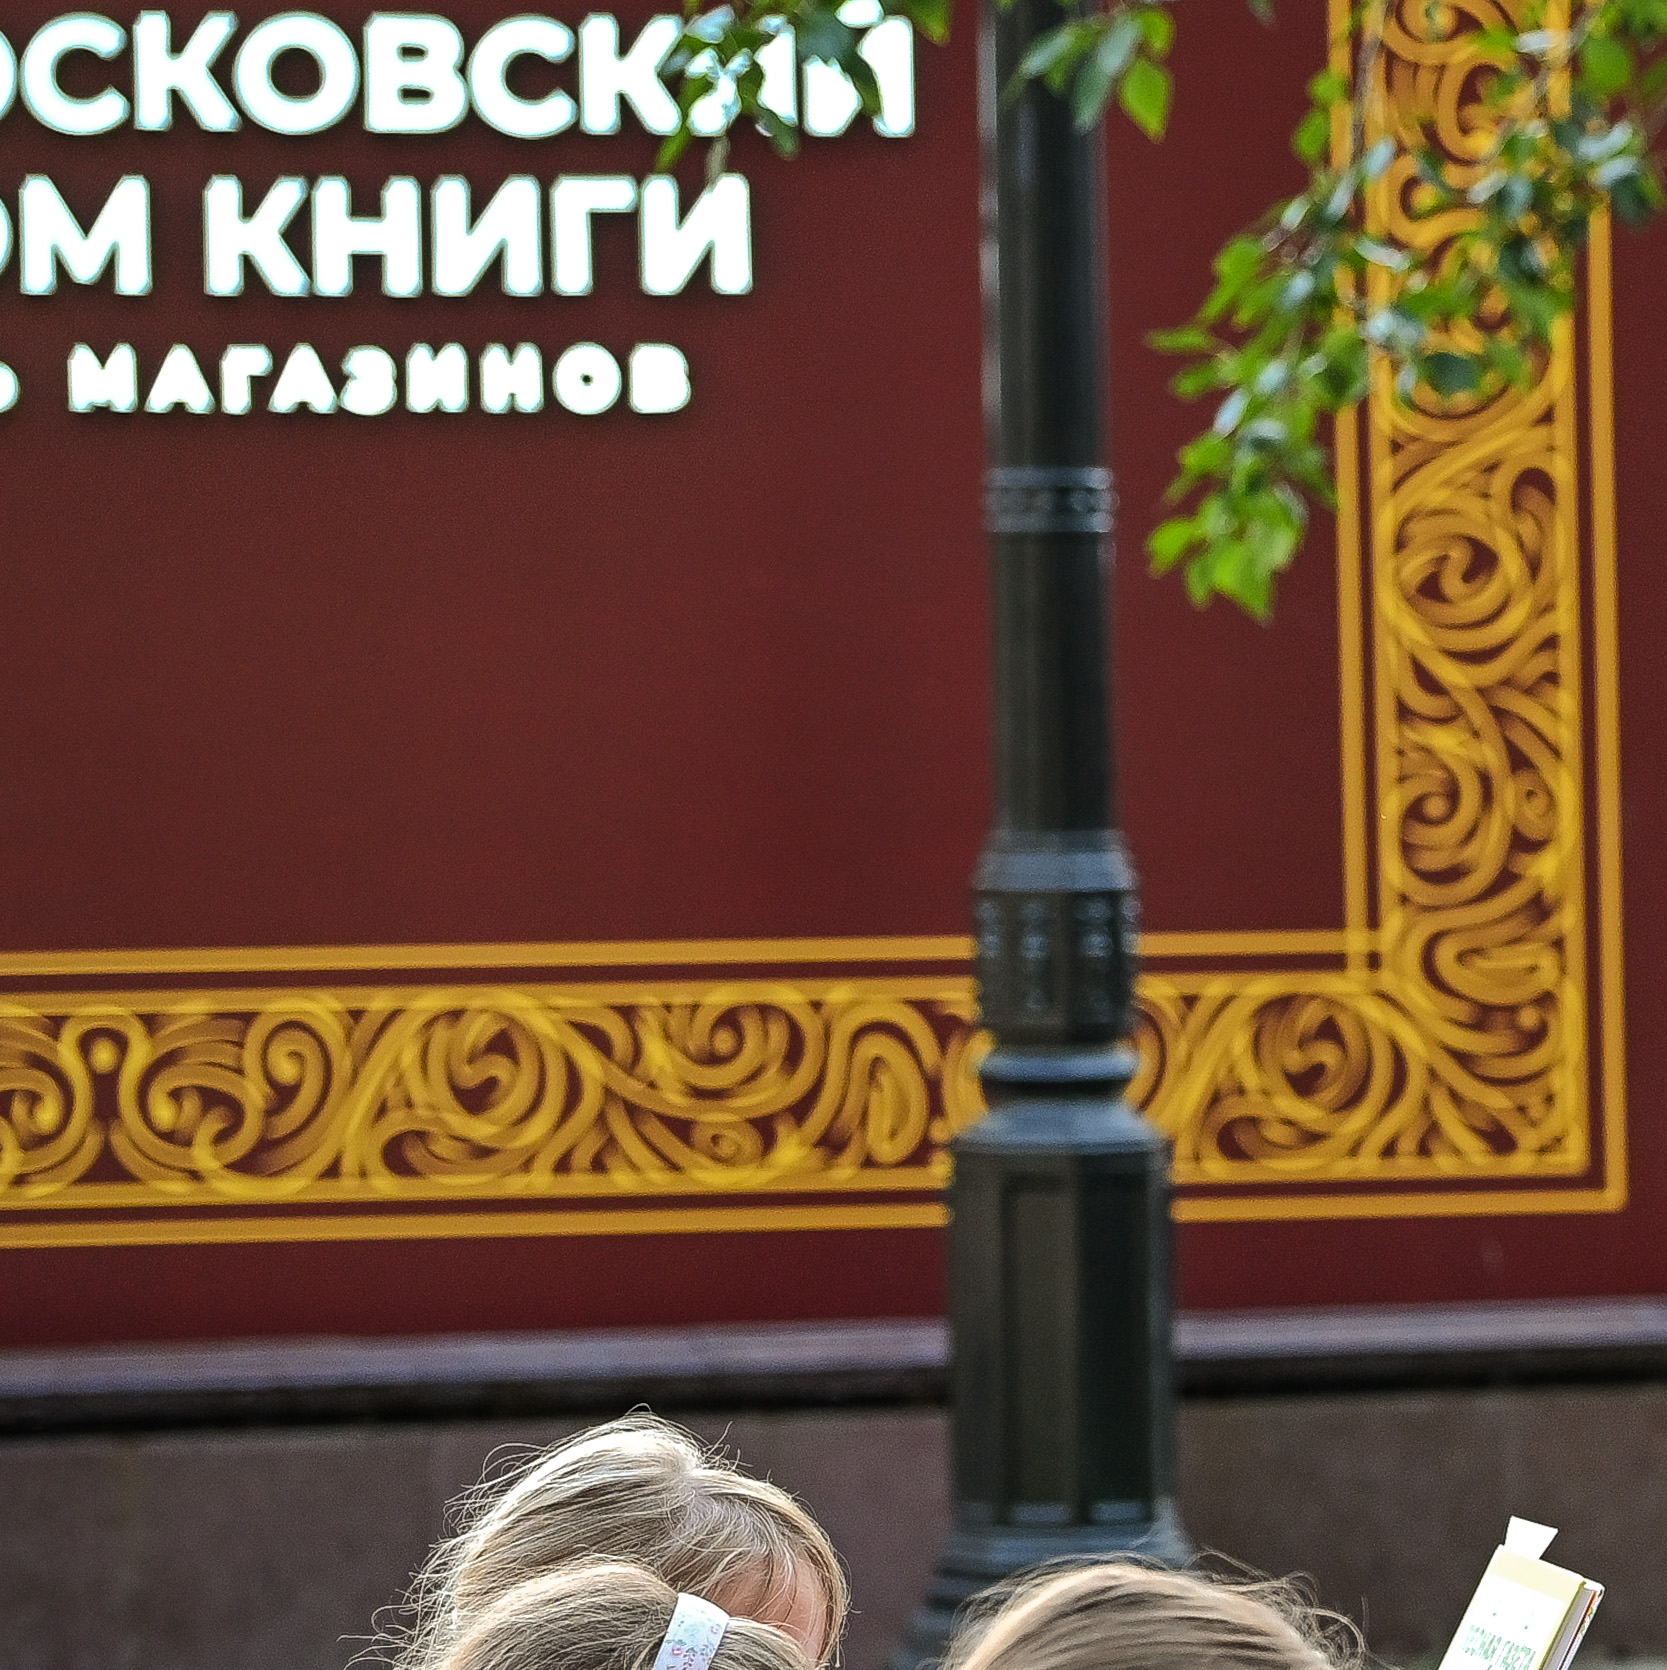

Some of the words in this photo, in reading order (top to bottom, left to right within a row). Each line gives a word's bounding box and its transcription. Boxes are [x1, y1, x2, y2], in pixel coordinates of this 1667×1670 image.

[0, 175, 152, 295] М
[203, 173, 752, 297] КНИГИ
[67, 342, 691, 415] МАГАЗИНОВ
